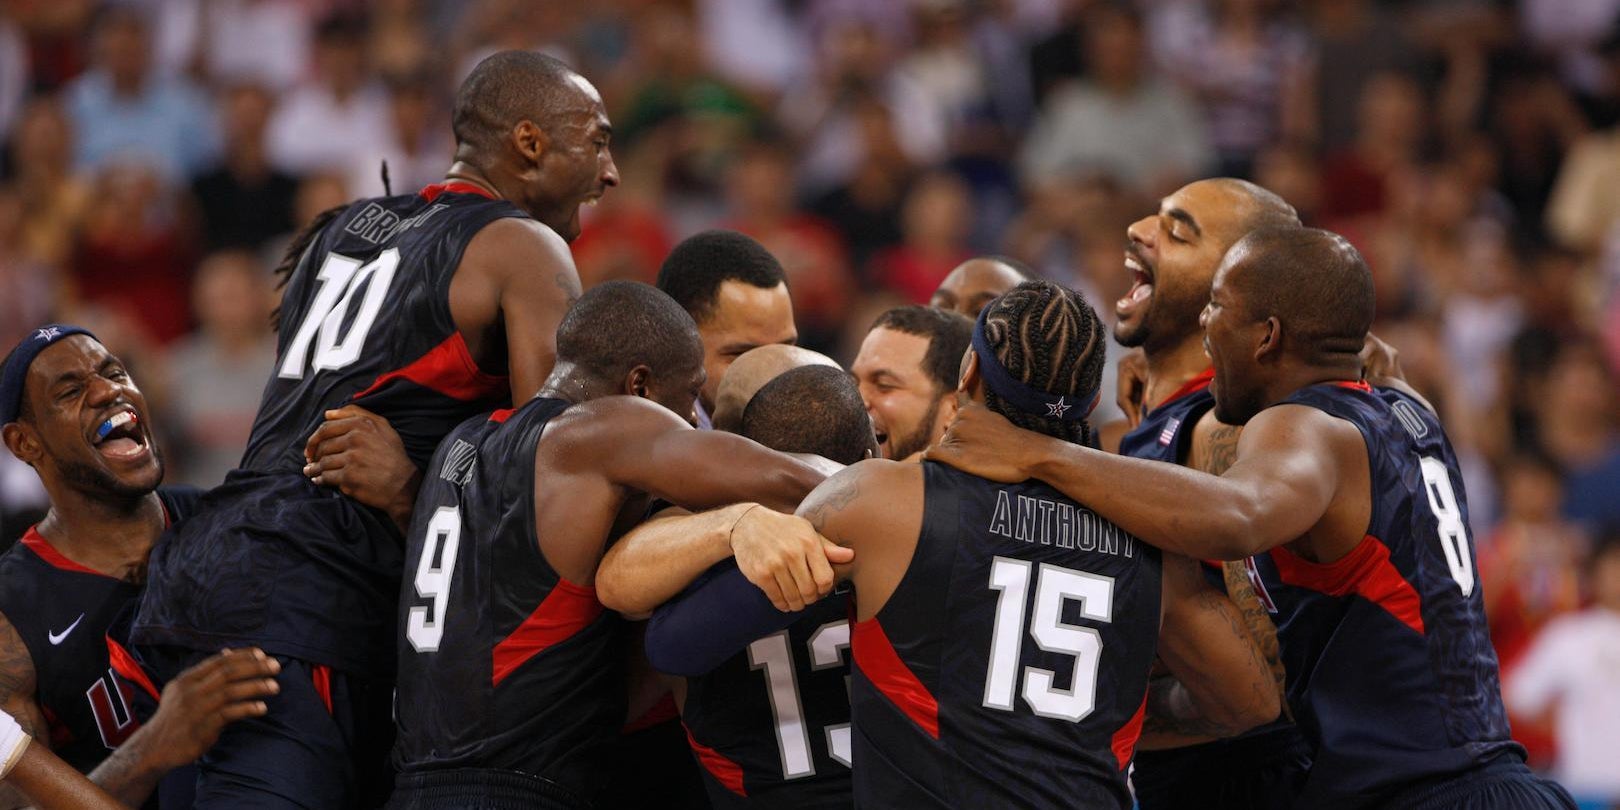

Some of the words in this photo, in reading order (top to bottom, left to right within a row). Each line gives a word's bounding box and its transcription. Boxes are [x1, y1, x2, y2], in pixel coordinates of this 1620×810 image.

[278, 247, 401, 379] 10
[406, 506, 461, 653] 9
[1420, 456, 1475, 598] 8
[982, 555, 1115, 724] 15
